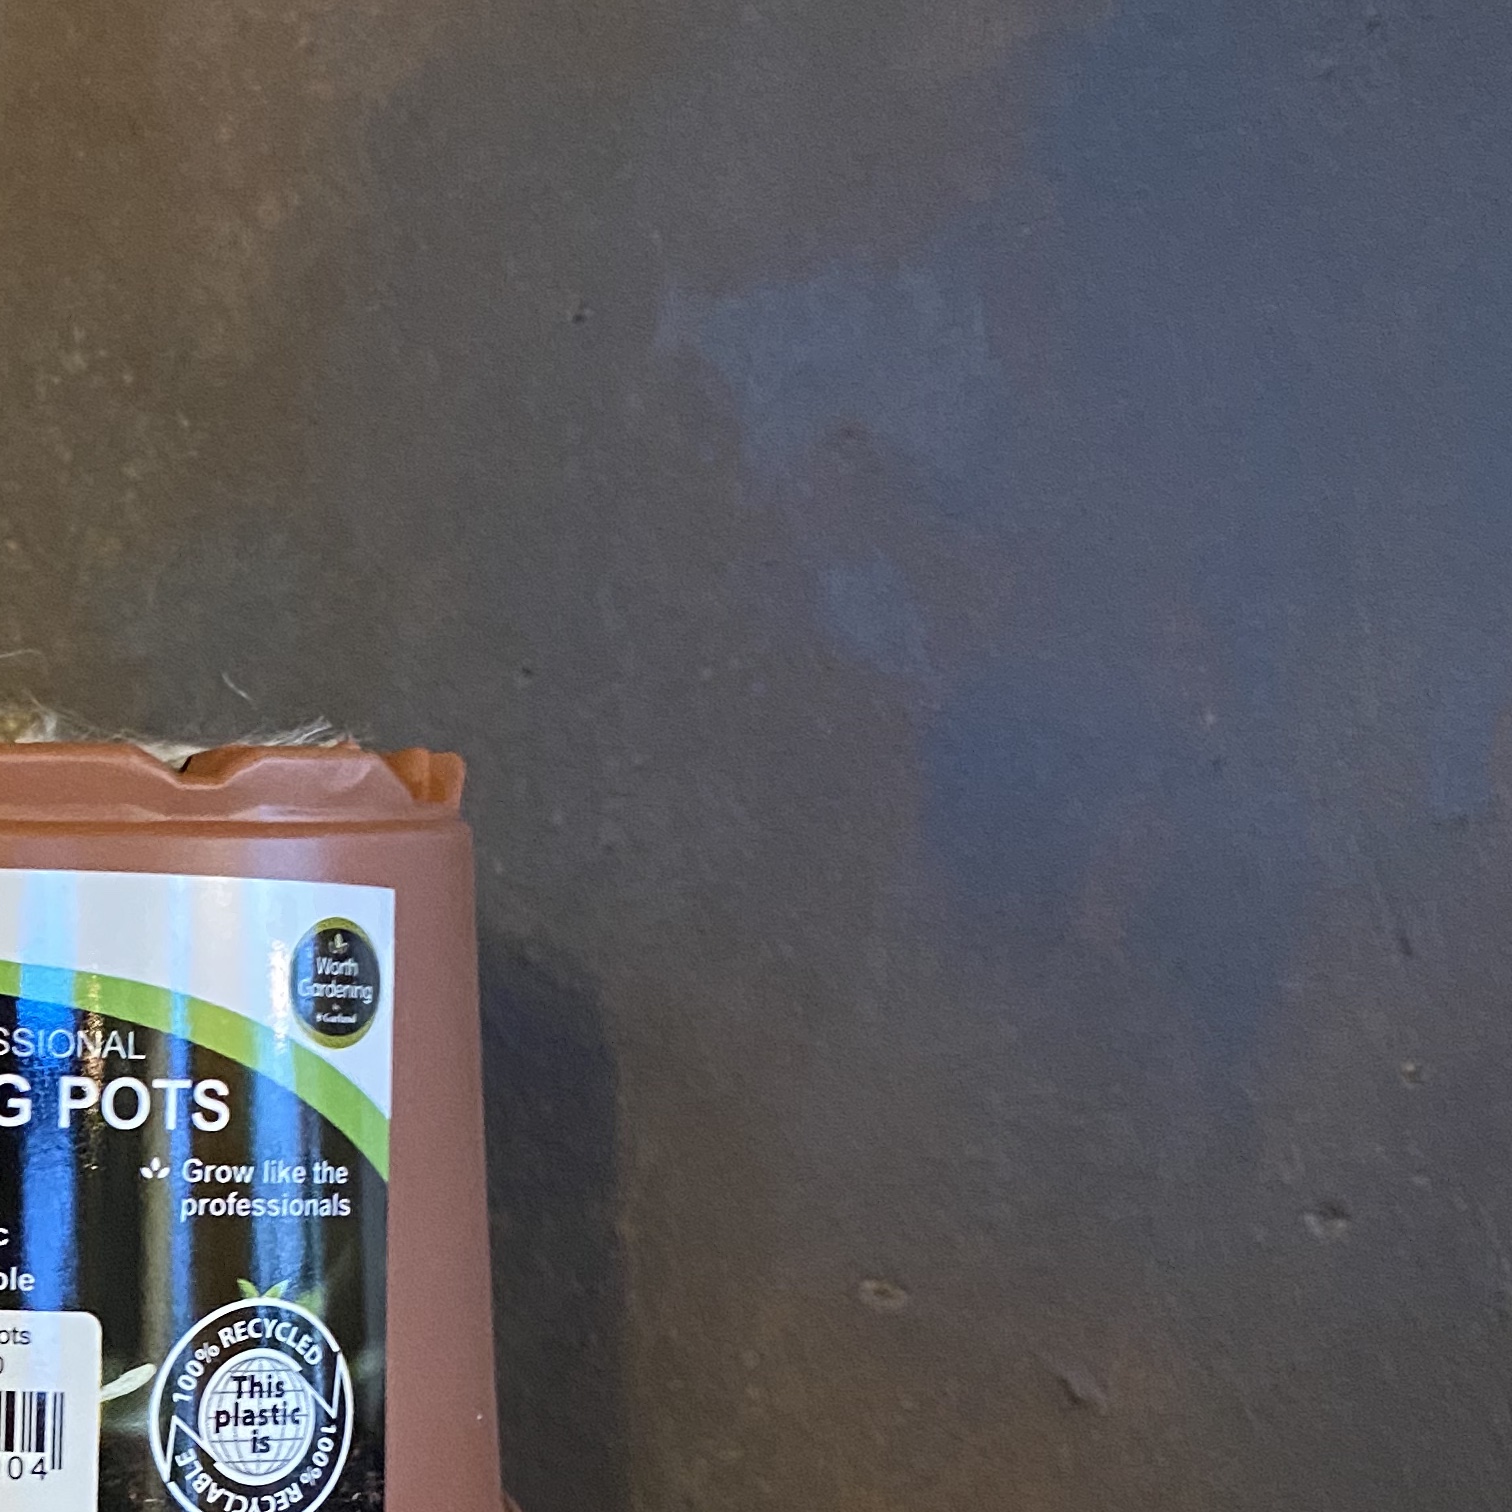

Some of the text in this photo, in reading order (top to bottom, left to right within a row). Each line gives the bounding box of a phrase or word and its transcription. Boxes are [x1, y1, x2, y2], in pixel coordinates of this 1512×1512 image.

[316, 957, 359, 976] Worth
[297, 979, 373, 1005] Gardening
[58, 1076, 231, 1132] POTS
[182, 1158, 349, 1185] Grow like the
[180, 1192, 352, 1222] professionals
[172, 1317, 323, 1403] 100% RECYCLED
[230, 1374, 285, 1399] This
[214, 1403, 301, 1433] plastic
[251, 1430, 270, 1454] is
[299, 1424, 337, 1487] 100%
